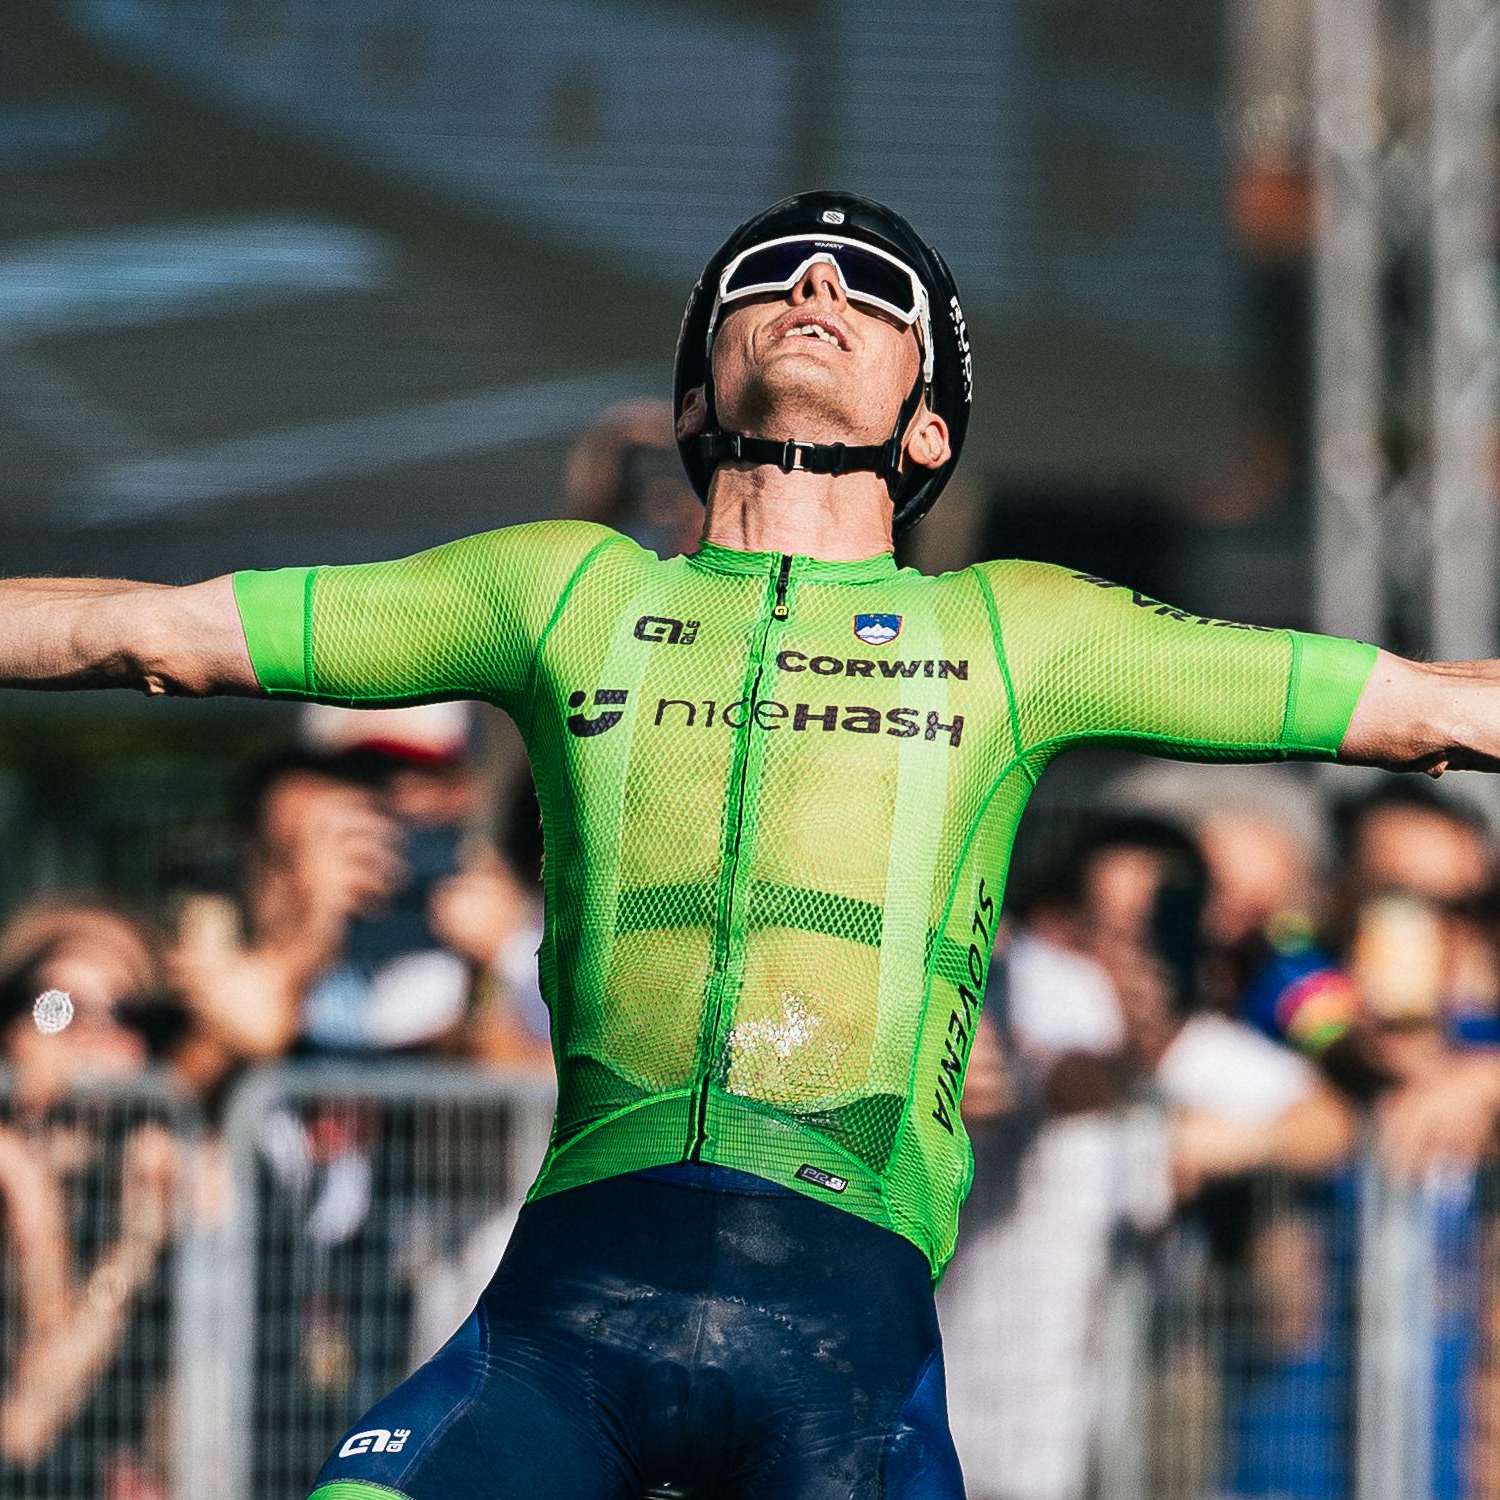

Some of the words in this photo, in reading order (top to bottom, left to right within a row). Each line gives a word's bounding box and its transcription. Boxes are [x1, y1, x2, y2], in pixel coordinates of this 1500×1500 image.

[949, 296, 973, 403] RUDY
[775, 650, 969, 681] CORWIN
[933, 878, 994, 1135] SLOVENIA
